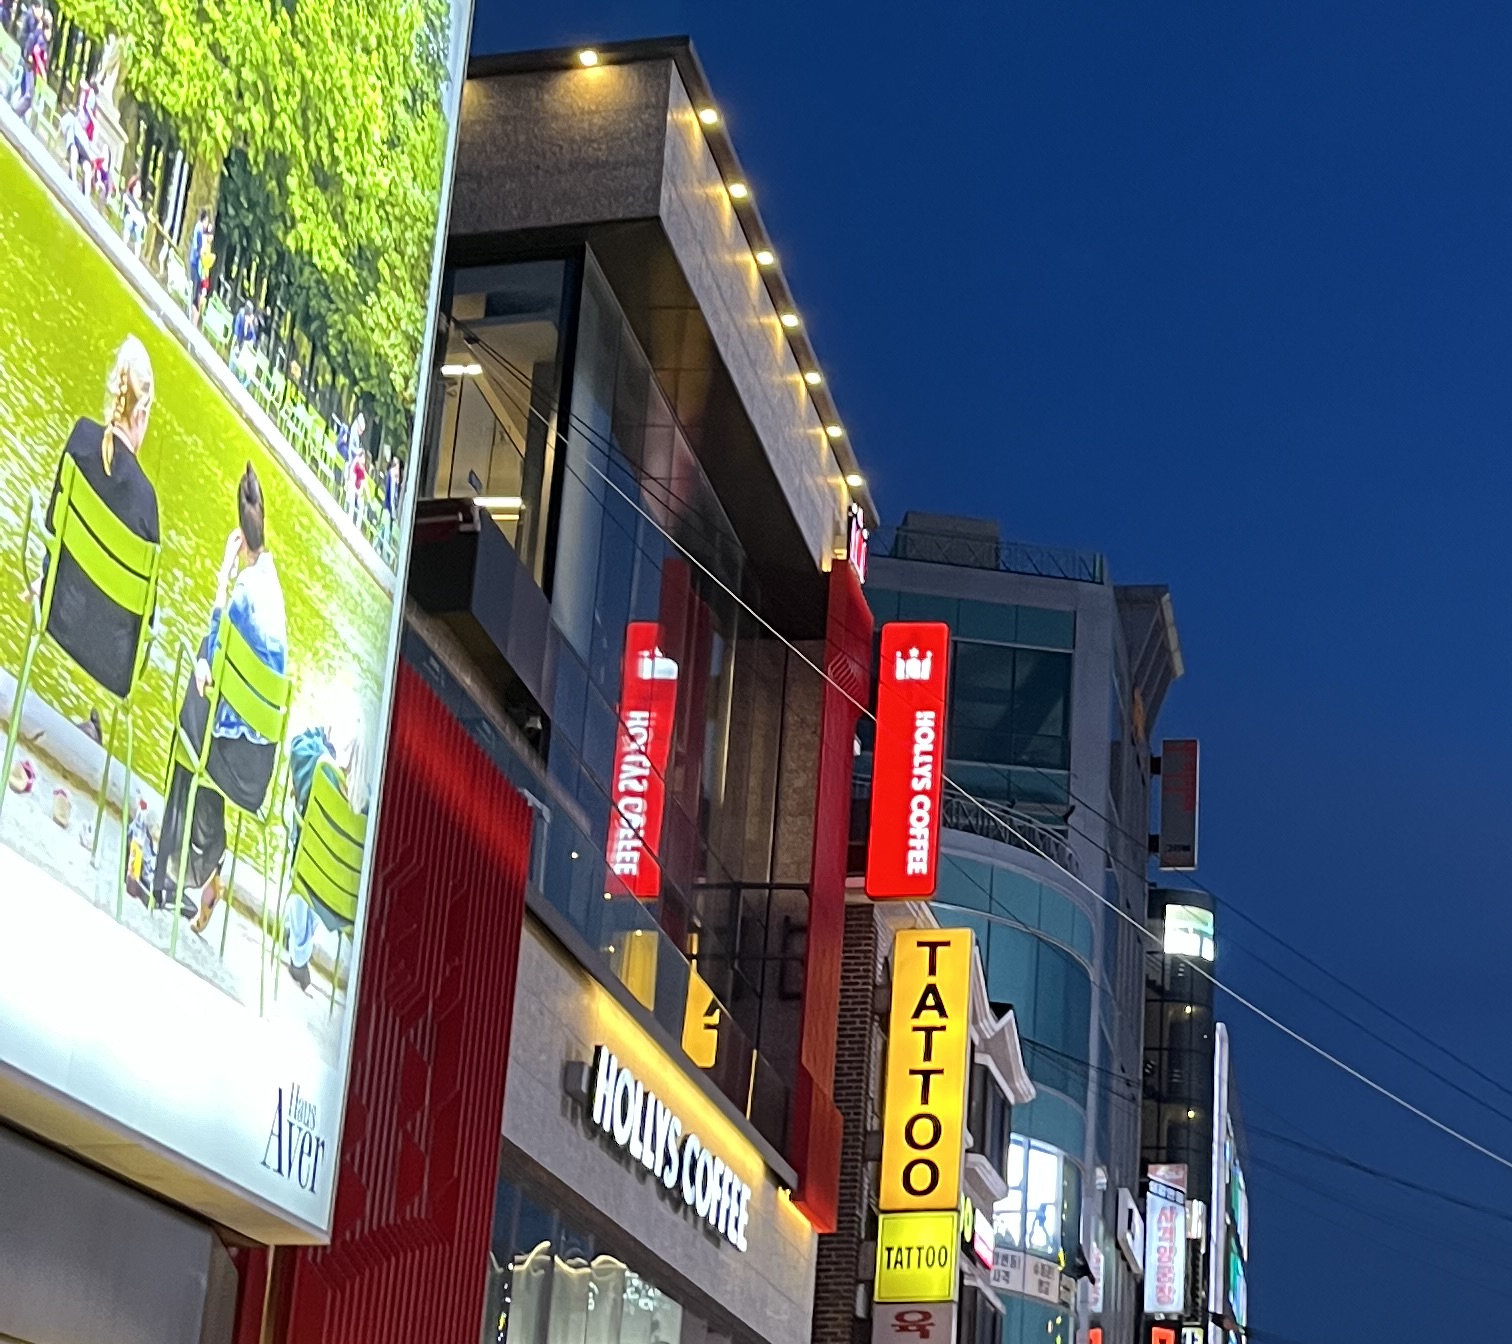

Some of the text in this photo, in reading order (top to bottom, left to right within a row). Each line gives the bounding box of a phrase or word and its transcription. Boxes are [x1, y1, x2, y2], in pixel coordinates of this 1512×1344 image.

[906, 711, 936, 876] HOLLYS COFFEE
[288, 1082, 317, 1131] Haus
[902, 940, 951, 1197] TATTOO
[261, 1087, 325, 1194] Aver
[593, 1045, 751, 1253] HOLLYS COFFEE
[885, 1246, 948, 1270] TATTOO
